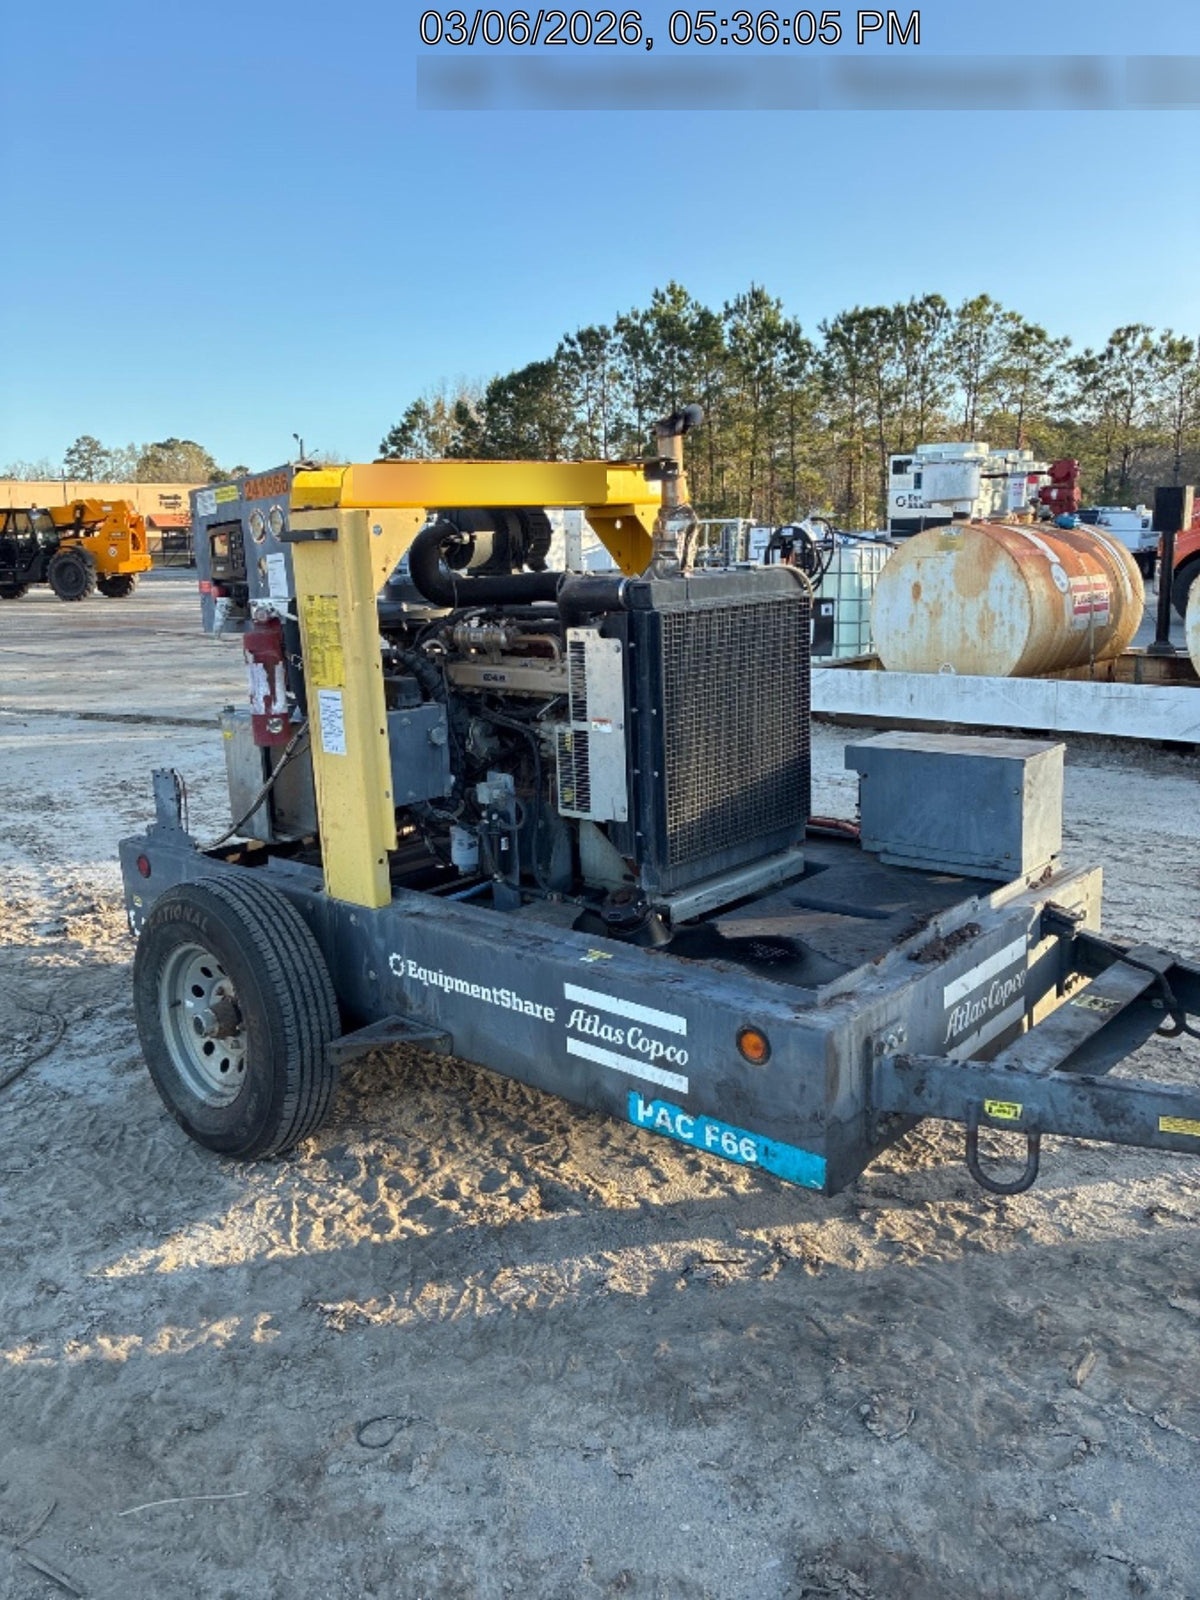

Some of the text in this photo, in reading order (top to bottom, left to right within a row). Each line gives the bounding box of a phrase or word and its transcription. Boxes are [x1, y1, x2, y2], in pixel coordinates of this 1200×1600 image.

[406, 959, 556, 1023] EquipmentShare
[943, 969, 1026, 1044] Atlas Copco
[565, 1008, 689, 1066] Atlas Copco
[705, 1123, 758, 1162] F66
